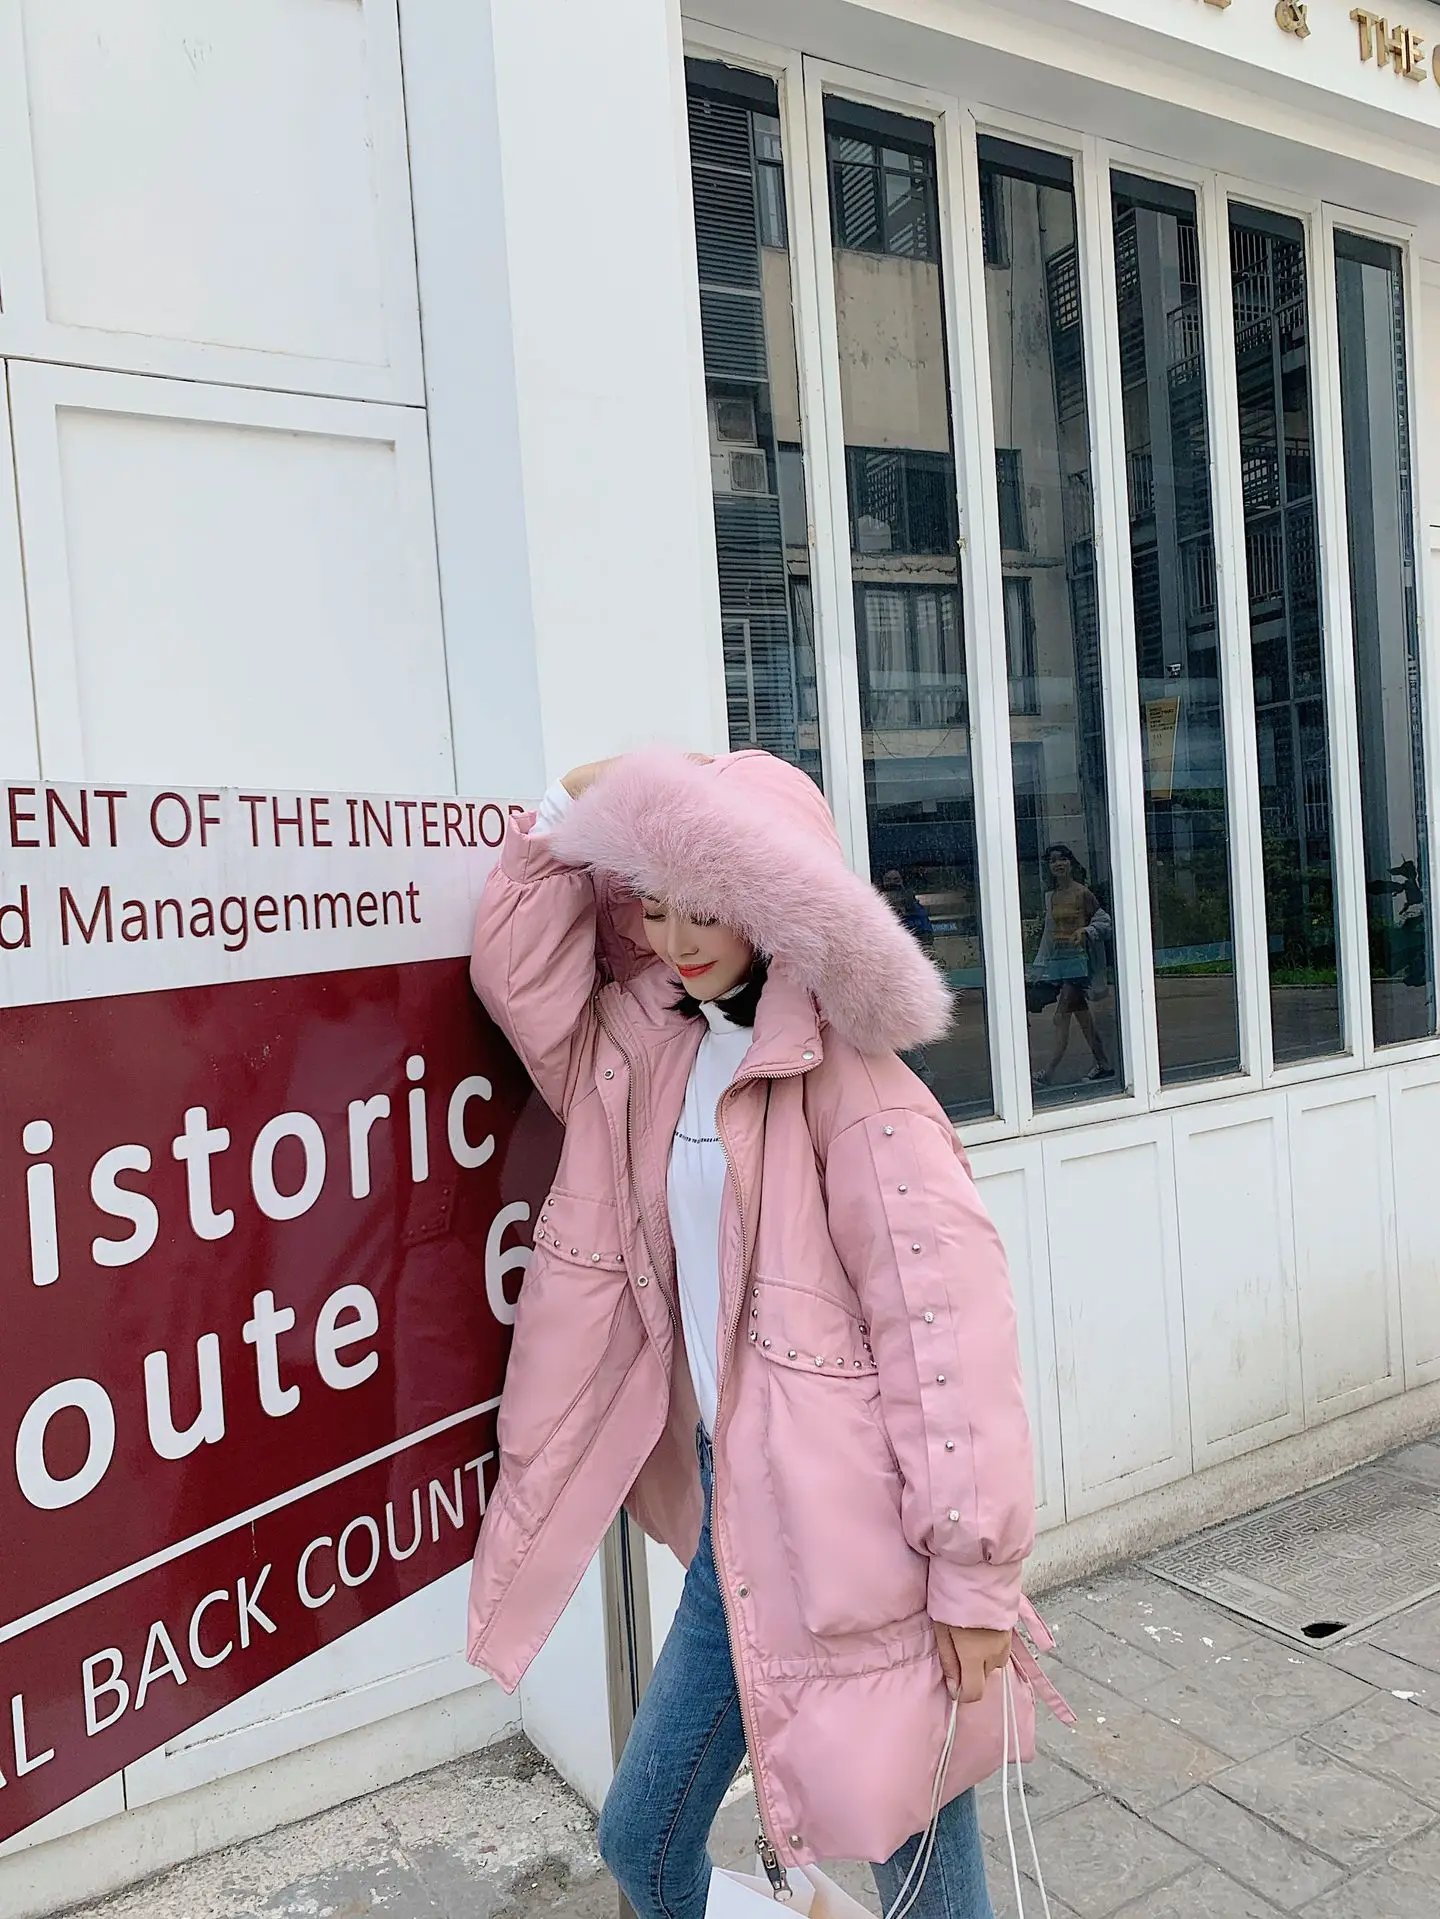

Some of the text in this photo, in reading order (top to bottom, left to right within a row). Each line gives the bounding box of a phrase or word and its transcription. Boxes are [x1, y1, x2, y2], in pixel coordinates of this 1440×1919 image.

[1349, 7, 1440, 88] THE
[7, 787, 526, 848] ENT OF THE INTERIO
[0, 880, 422, 952] d Managenment
[22, 1054, 496, 1287] istoric
[14, 1200, 534, 1511] oute 6
[0, 1450, 495, 1789] L BACK COUNT
